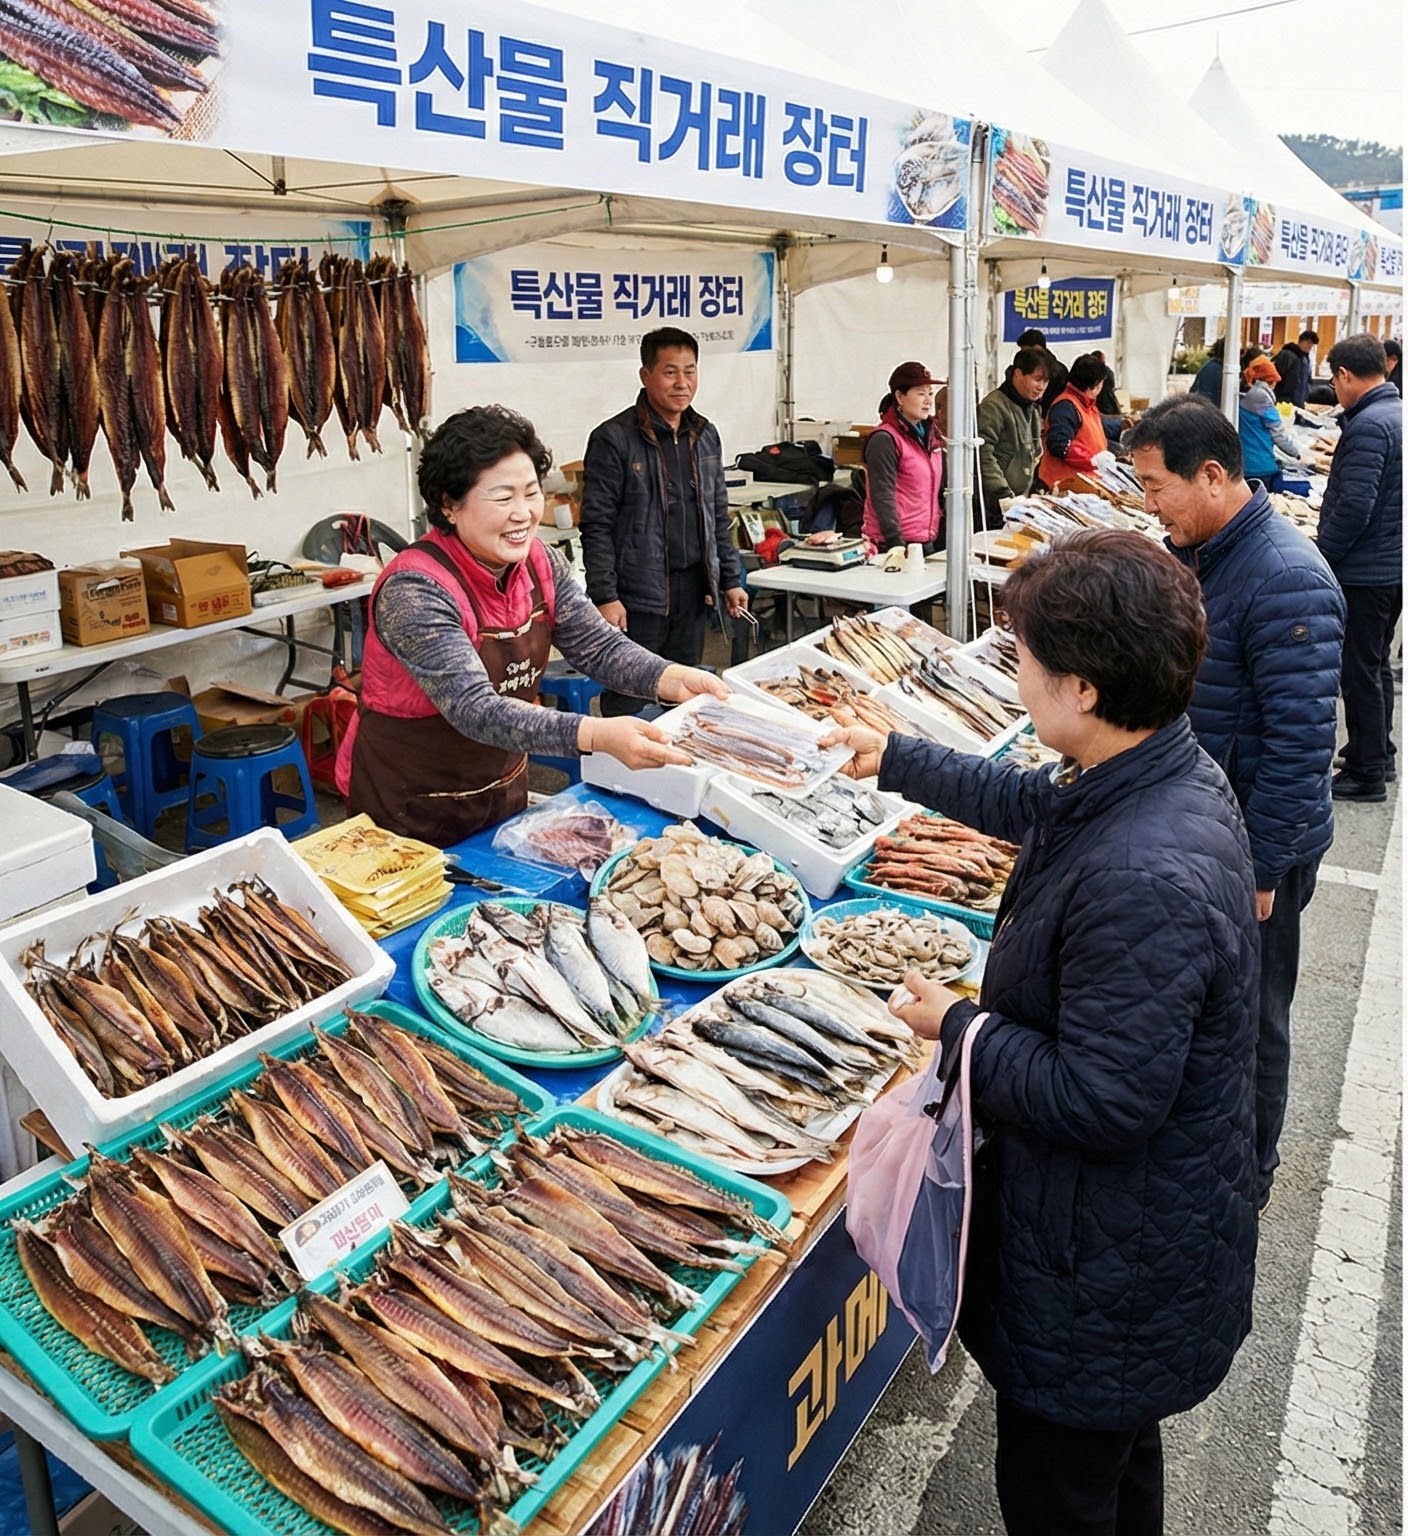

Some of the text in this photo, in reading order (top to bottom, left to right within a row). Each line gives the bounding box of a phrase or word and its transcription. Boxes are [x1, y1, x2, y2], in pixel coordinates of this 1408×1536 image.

[308, 0, 868, 193] 특산물 직거래 장터
[1065, 167, 1214, 245] 특산물 직거래 장터
[511, 270, 743, 320] 특산물 직거래 장터
[1014, 289, 1049, 319] 특산물
